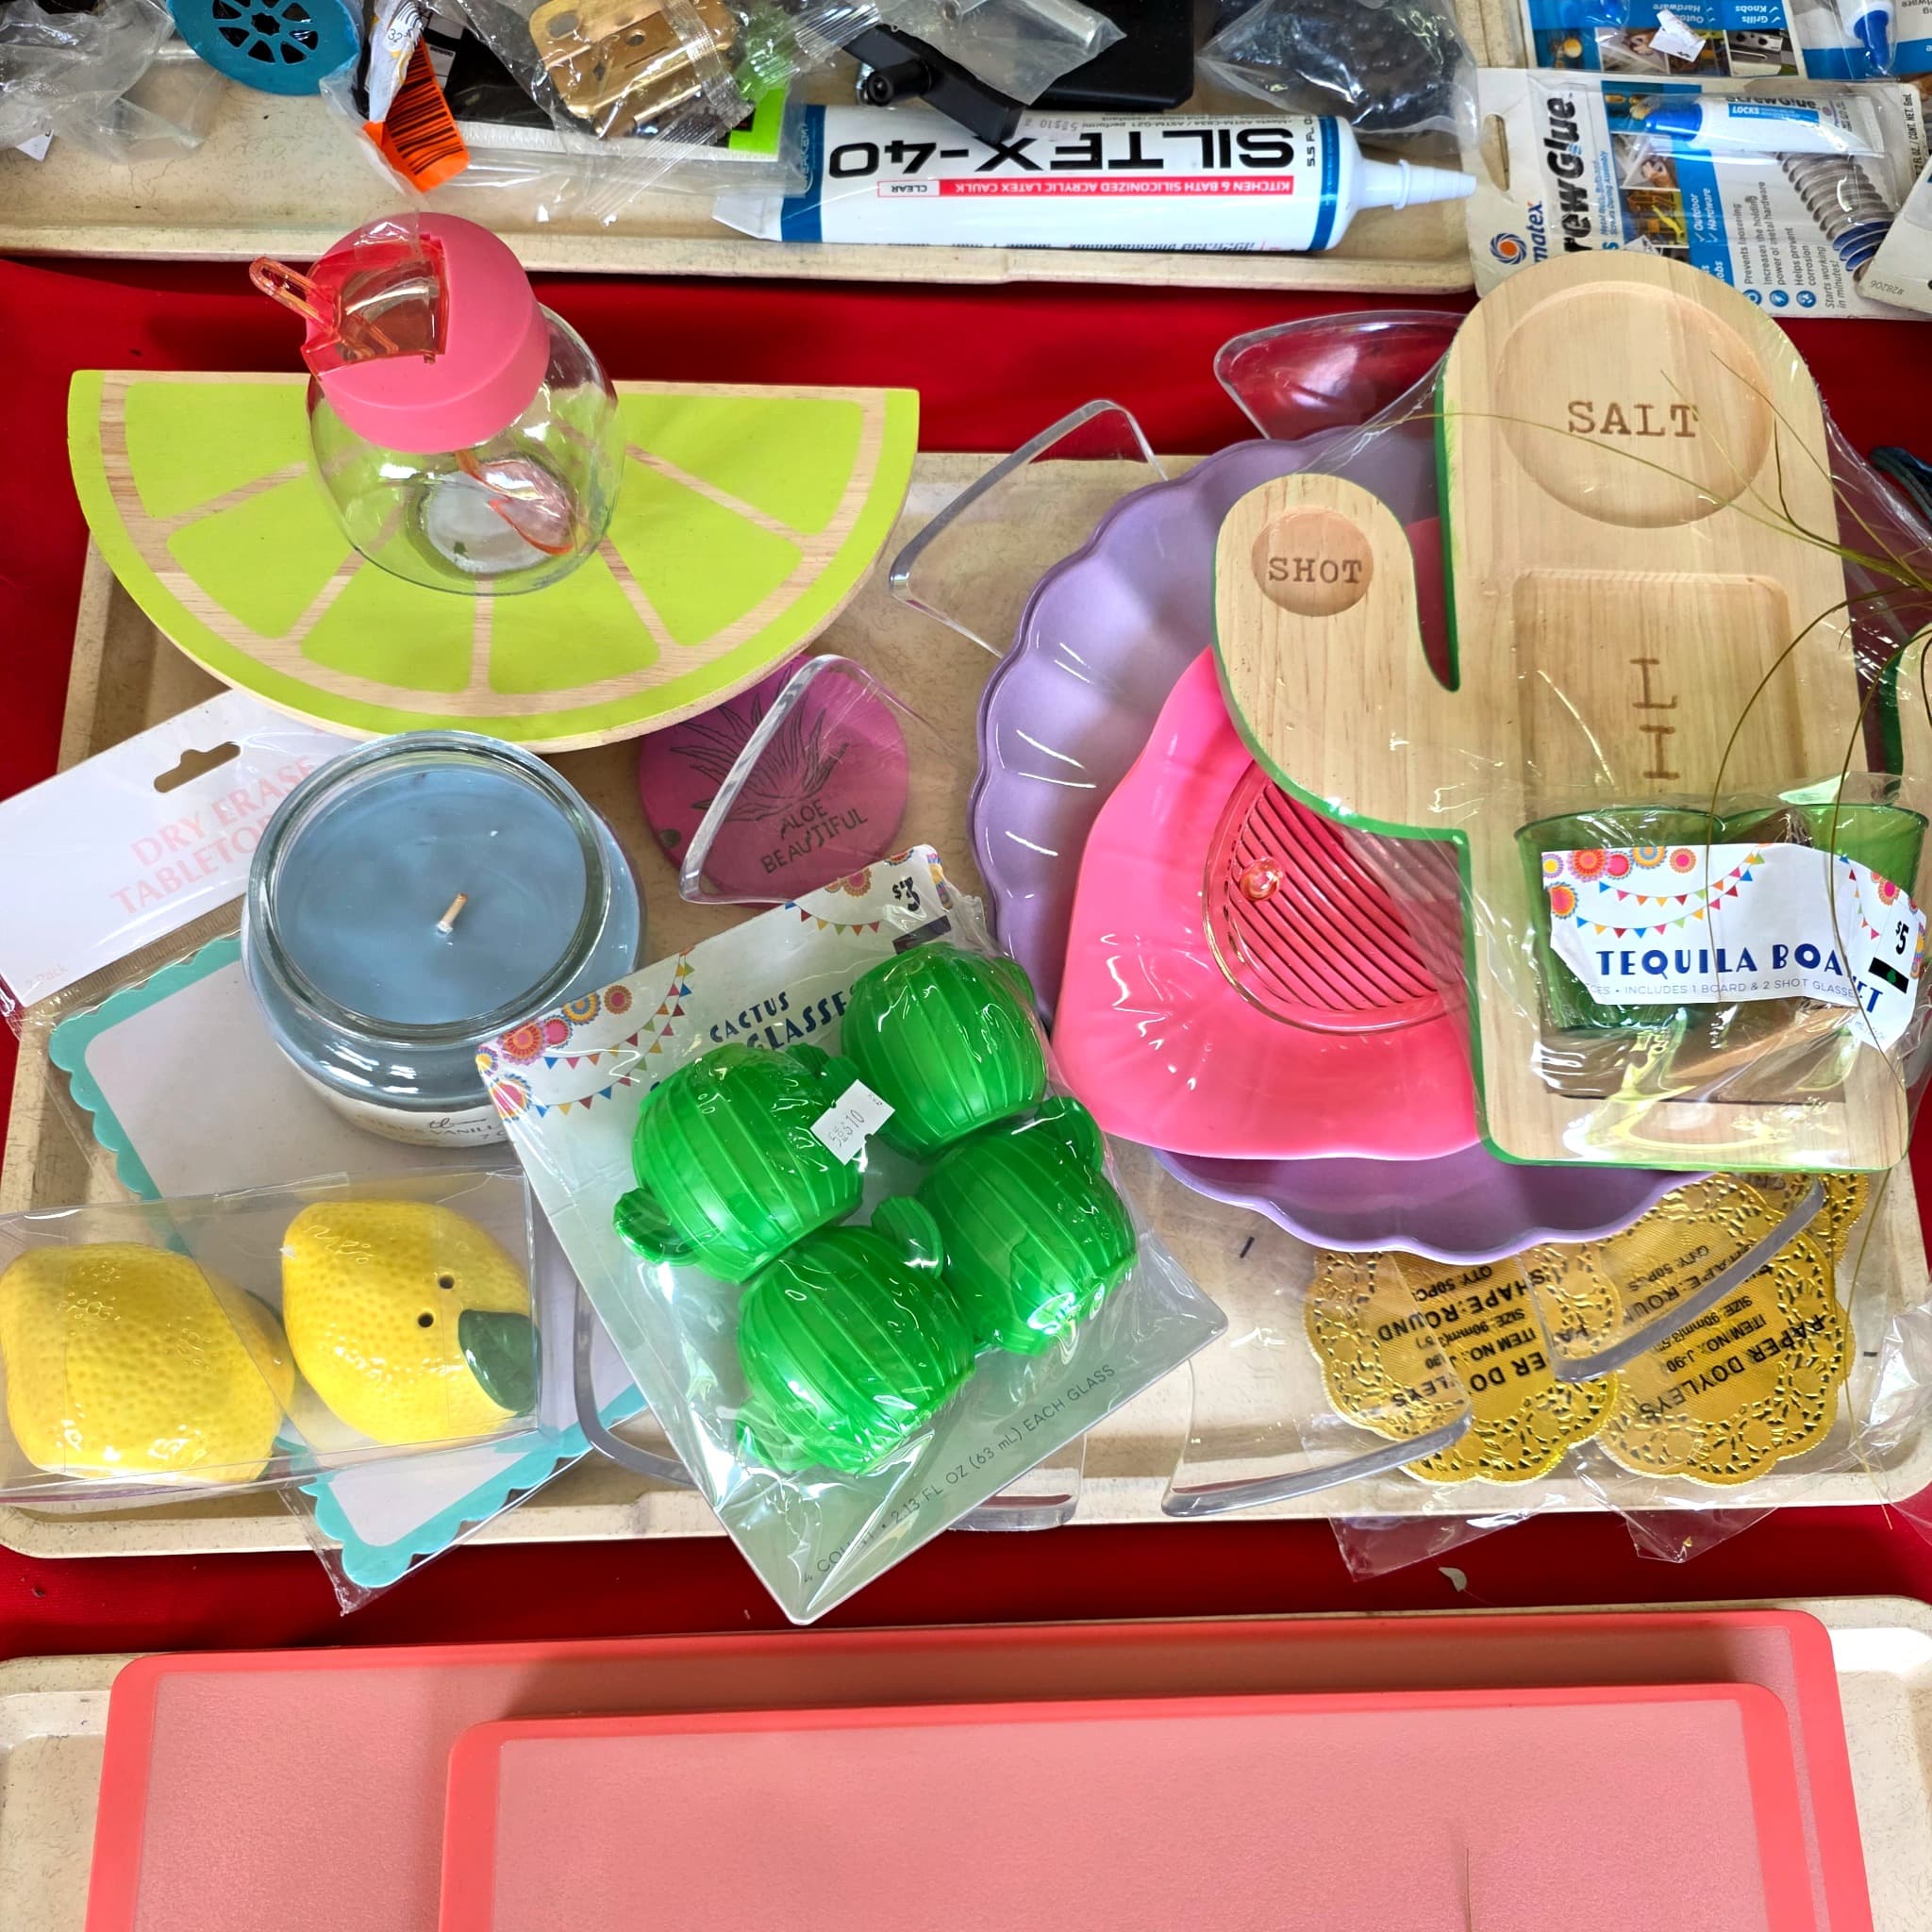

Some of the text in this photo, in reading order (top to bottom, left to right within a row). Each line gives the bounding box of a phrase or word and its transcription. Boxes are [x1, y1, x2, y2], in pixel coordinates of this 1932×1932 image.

[1678, 14, 1705, 25] Outd
[1735, 5, 1768, 14] Knobs
[1740, 14, 1769, 25] Grills
[1732, 106, 1759, 115] LOCKS
[1906, 108, 1916, 122] NET.
[1907, 123, 1919, 140] CONT.
[828, 127, 1294, 179] SILTEX-40
[891, 184, 928, 193] CLEAR
[955, 180, 1291, 194] KITCHEN & BATH SILICONIZED ACRYLIC LATEX CAULK
[1542, 97, 1593, 253] rewGlue
[1690, 193, 1705, 231] Outdoor
[1703, 189, 1717, 231] Hardware
[1757, 181, 1773, 221] hardware
[1525, 201, 1548, 262] matex
[1732, 204, 1754, 285] Prevents loosening
[1749, 195, 1773, 285] Increases the holding
[1767, 222, 1777, 245] metal
[1773, 258, 1787, 286] power
[1785, 227, 1806, 287] Helps prevent
[1802, 245, 1817, 286] corrosion
[1816, 246, 1835, 309] Starts working
[1830, 260, 1846, 309] in minutes!
[1567, 401, 1701, 440] SALT
[1268, 556, 1364, 585] SHOT
[130, 811, 206, 867] DRY
[780, 799, 828, 841] ALOE
[760, 808, 869, 874] BEAUTIFUL
[892, 876, 921, 912] $3
[1894, 920, 1910, 956] $5
[1595, 946, 1757, 980] TEQUILA
[1772, 942, 1843, 976] BOA
[1624, 984, 1688, 995] INCLUDES
[1701, 982, 1746, 994] BOARD
[1751, 982, 1758, 991] &
[1763, 980, 1771, 990] 2
[1774, 977, 1808, 990] SHOT
[1812, 979, 1856, 999] GLASSE
[710, 991, 790, 1043] CACTUS
[747, 983, 854, 1051] GLASSE
[1410, 1277, 1455, 1303] 50PC
[1719, 1295, 1753, 1317] SIZE:
[1496, 1327, 1537, 1350] ITEM
[1728, 1313, 1767, 1341] ITEM
[1638, 1314, 1825, 1421] PAPER DOYLEYS
[1666, 1349, 1695, 1373] J-90
[1391, 1366, 1506, 1408] DOLEYS
[891, 1497, 921, 1524] 2.13
[922, 1484, 944, 1502] FL
[945, 1464, 970, 1485] OZ
[969, 1446, 995, 1470] (63
[997, 1426, 1024, 1451] mL)
[1023, 1397, 1066, 1433] EACH
[1067, 1363, 1116, 1402] GLASS
